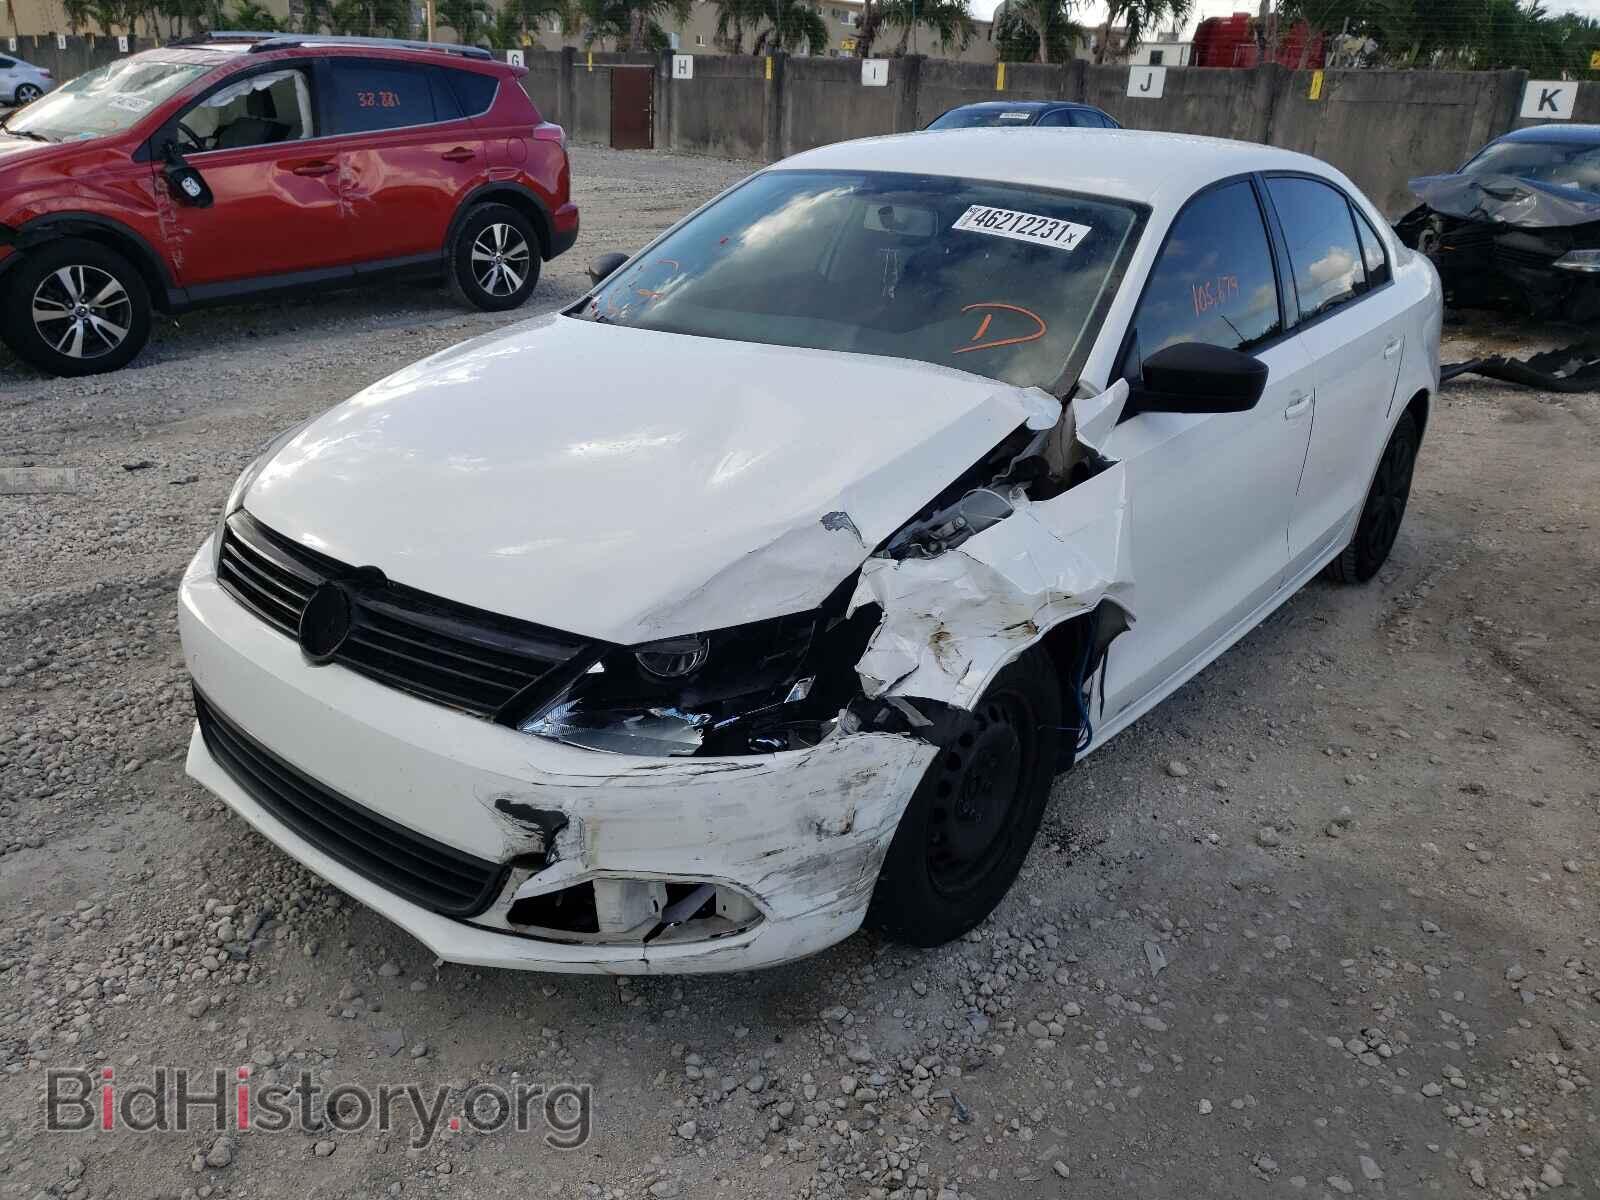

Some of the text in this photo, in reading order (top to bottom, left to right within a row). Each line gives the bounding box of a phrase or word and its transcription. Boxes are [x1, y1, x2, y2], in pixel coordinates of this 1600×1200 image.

[511, 54, 519, 66] G
[678, 61, 687, 74] H
[1140, 73, 1153, 92] J
[1537, 88, 1563, 112] K
[952, 302, 1049, 354] D
